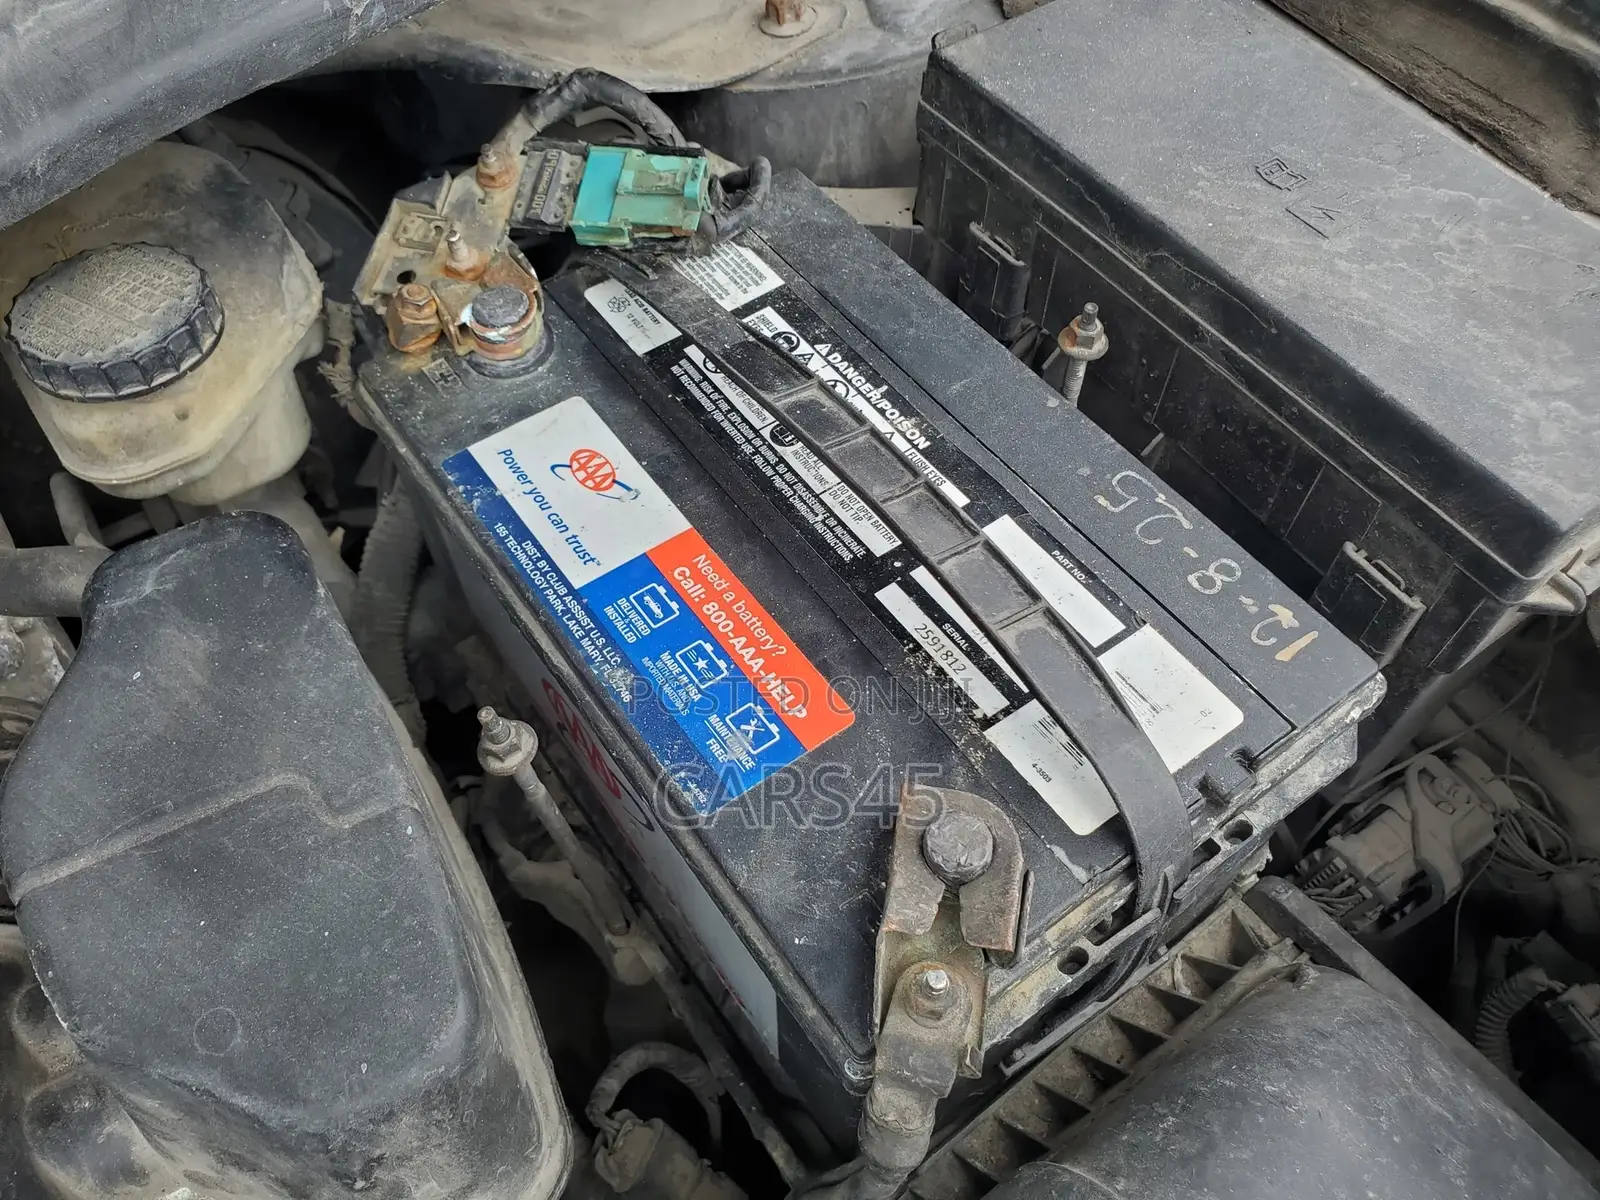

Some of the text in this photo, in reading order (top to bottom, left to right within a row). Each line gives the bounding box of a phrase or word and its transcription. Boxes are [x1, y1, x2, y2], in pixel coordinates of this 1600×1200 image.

[755, 313, 778, 333] SHIELD
[826, 352, 931, 450] DANGER/POISON
[670, 364, 683, 377] NOT
[678, 374, 716, 412] RECOMMENDED
[710, 410, 724, 423] FOR
[719, 419, 746, 445] INVERTED
[752, 454, 775, 478] FOLLOW
[770, 474, 794, 498] PROPER
[789, 495, 818, 524] CHARGING
[699, 379, 715, 395] RISK
[709, 392, 723, 401] OF
[727, 411, 756, 440] EXPLOSION
[751, 436, 763, 448] OR
[775, 463, 787, 474] DO
[782, 471, 798, 485] NOT
[792, 482, 832, 520] DISASSEMBLE
[825, 517, 838, 528] OR
[907, 451, 947, 487] FLUSH EYES
[497, 449, 533, 486] Power
[523, 487, 552, 512] you
[547, 511, 569, 533] can
[571, 450, 615, 491] AAA
[828, 489, 841, 501] DO
[838, 498, 852, 513] NOT
[836, 485, 899, 547] DO NOT OPEN BATTERY.
[1051, 550, 1074, 569] PART
[494, 522, 509, 538] 155
[504, 534, 551, 591] TECHNOLOGY
[544, 588, 566, 616] PARK,
[562, 613, 585, 639] LAKE
[580, 635, 604, 665] MARY,
[600, 664, 614, 680] FL
[521, 540, 541, 562] DIST.
[537, 559, 552, 574] BY
[546, 571, 568, 597] CLUB
[590, 628, 606, 649] U.S.
[602, 644, 621, 668] LLC.
[603, 605, 637, 644] INSTALLED
[616, 597, 651, 636] DELIVERED
[692, 553, 787, 657] Need a battery?
[673, 566, 808, 718] Call: 800-AAA-HELP
[914, 622, 967, 675] 2591812
[942, 622, 970, 651] SERIAL
[641, 656, 690, 717] IMPORTED MATERIALS
[655, 659, 671, 677] WITH
[676, 687, 690, 704] AND
[660, 650, 702, 702] MADE IN USA
[706, 738, 728, 763] FREE
[1032, 763, 1052, 783] 4-3503
